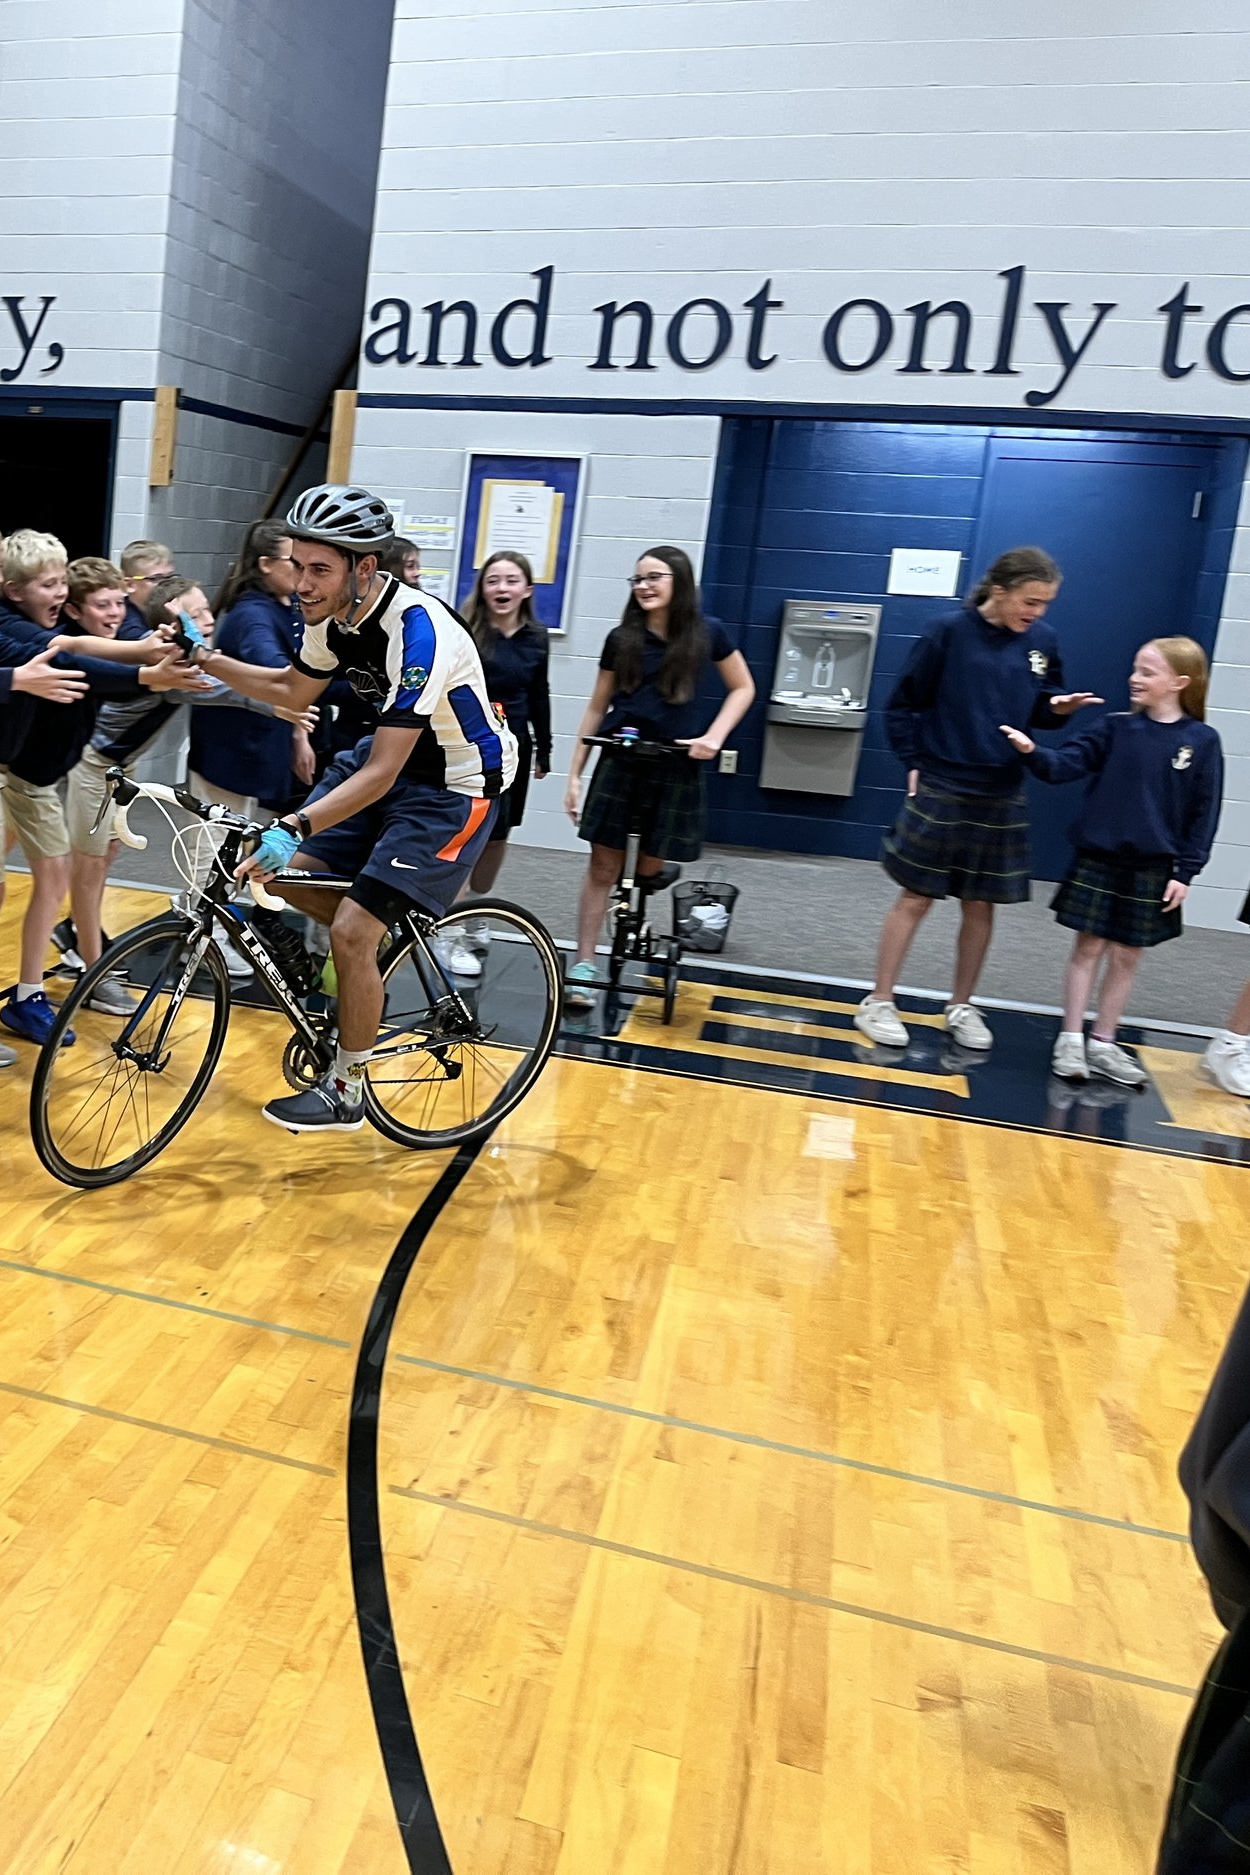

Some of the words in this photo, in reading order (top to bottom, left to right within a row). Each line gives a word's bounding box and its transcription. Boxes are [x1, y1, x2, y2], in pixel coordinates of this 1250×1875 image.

[363, 264, 555, 368] and
[586, 278, 784, 371] not
[822, 264, 1119, 407] only
[1157, 281, 1250, 382] to
[240, 928, 297, 1005] TREK
